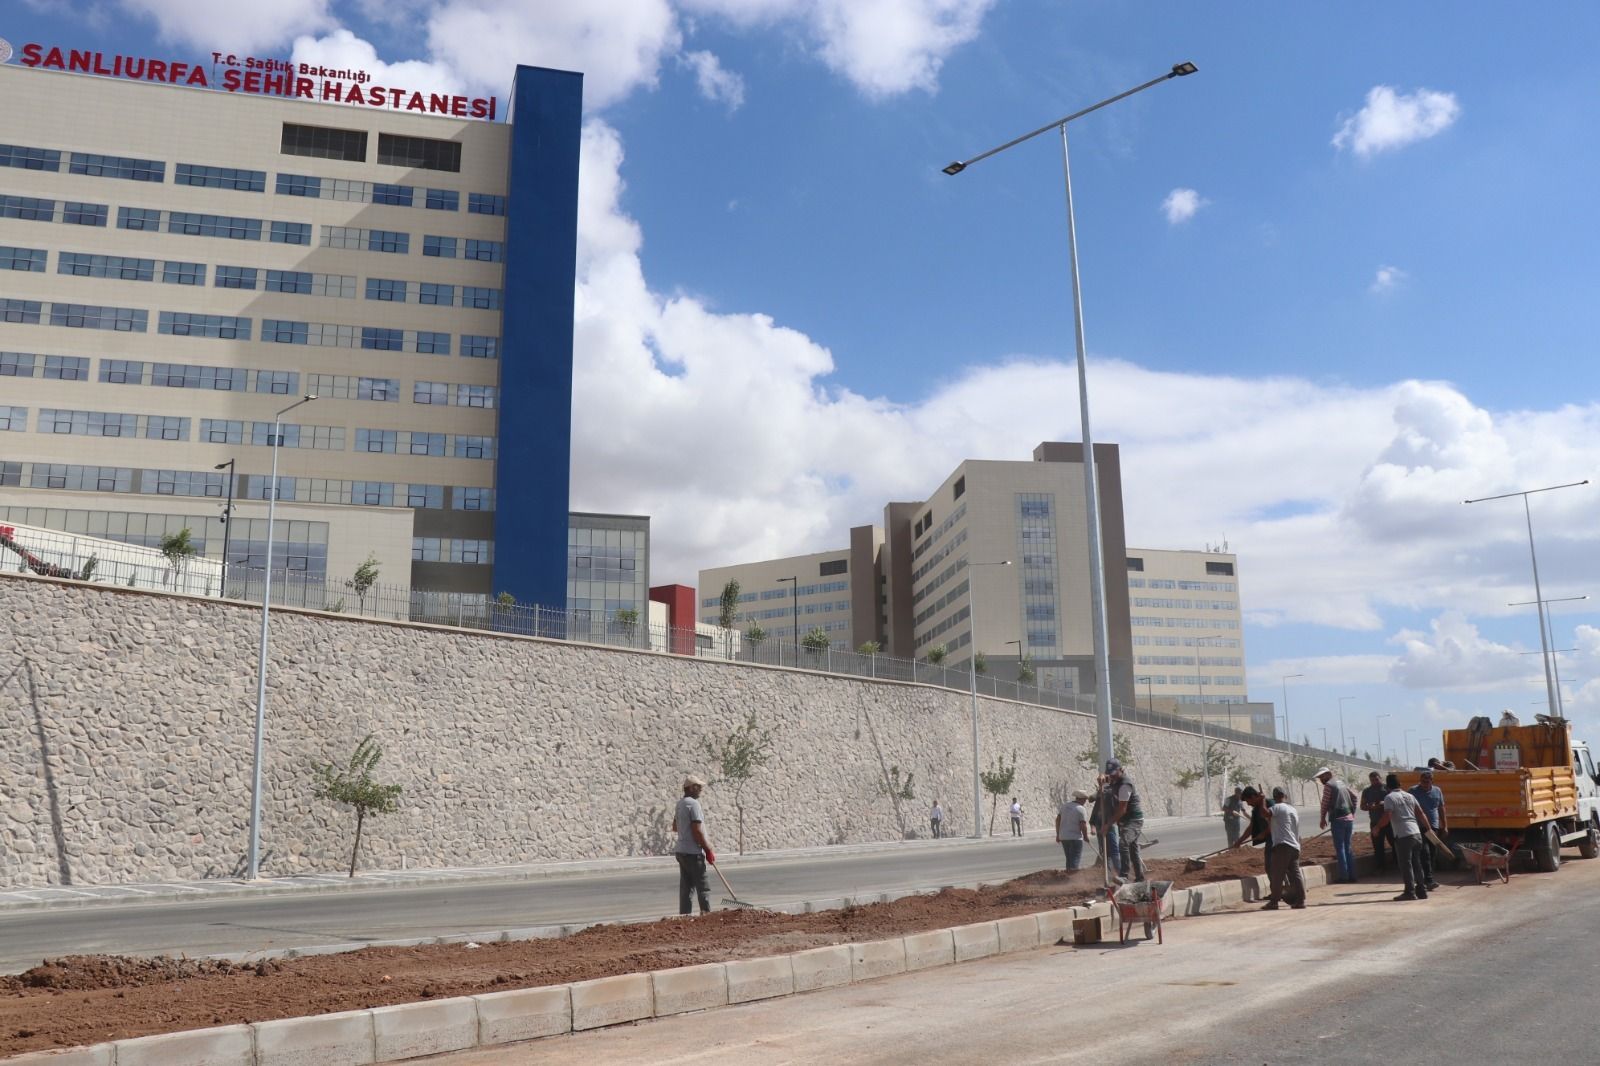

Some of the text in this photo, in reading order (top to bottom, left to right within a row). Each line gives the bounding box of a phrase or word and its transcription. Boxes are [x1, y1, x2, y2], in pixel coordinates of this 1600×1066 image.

[21, 43, 208, 87] ŞANLIURFA
[322, 80, 497, 120] HASTANESİ
[212, 52, 371, 83] T.C. Sağlık Bakanlığı
